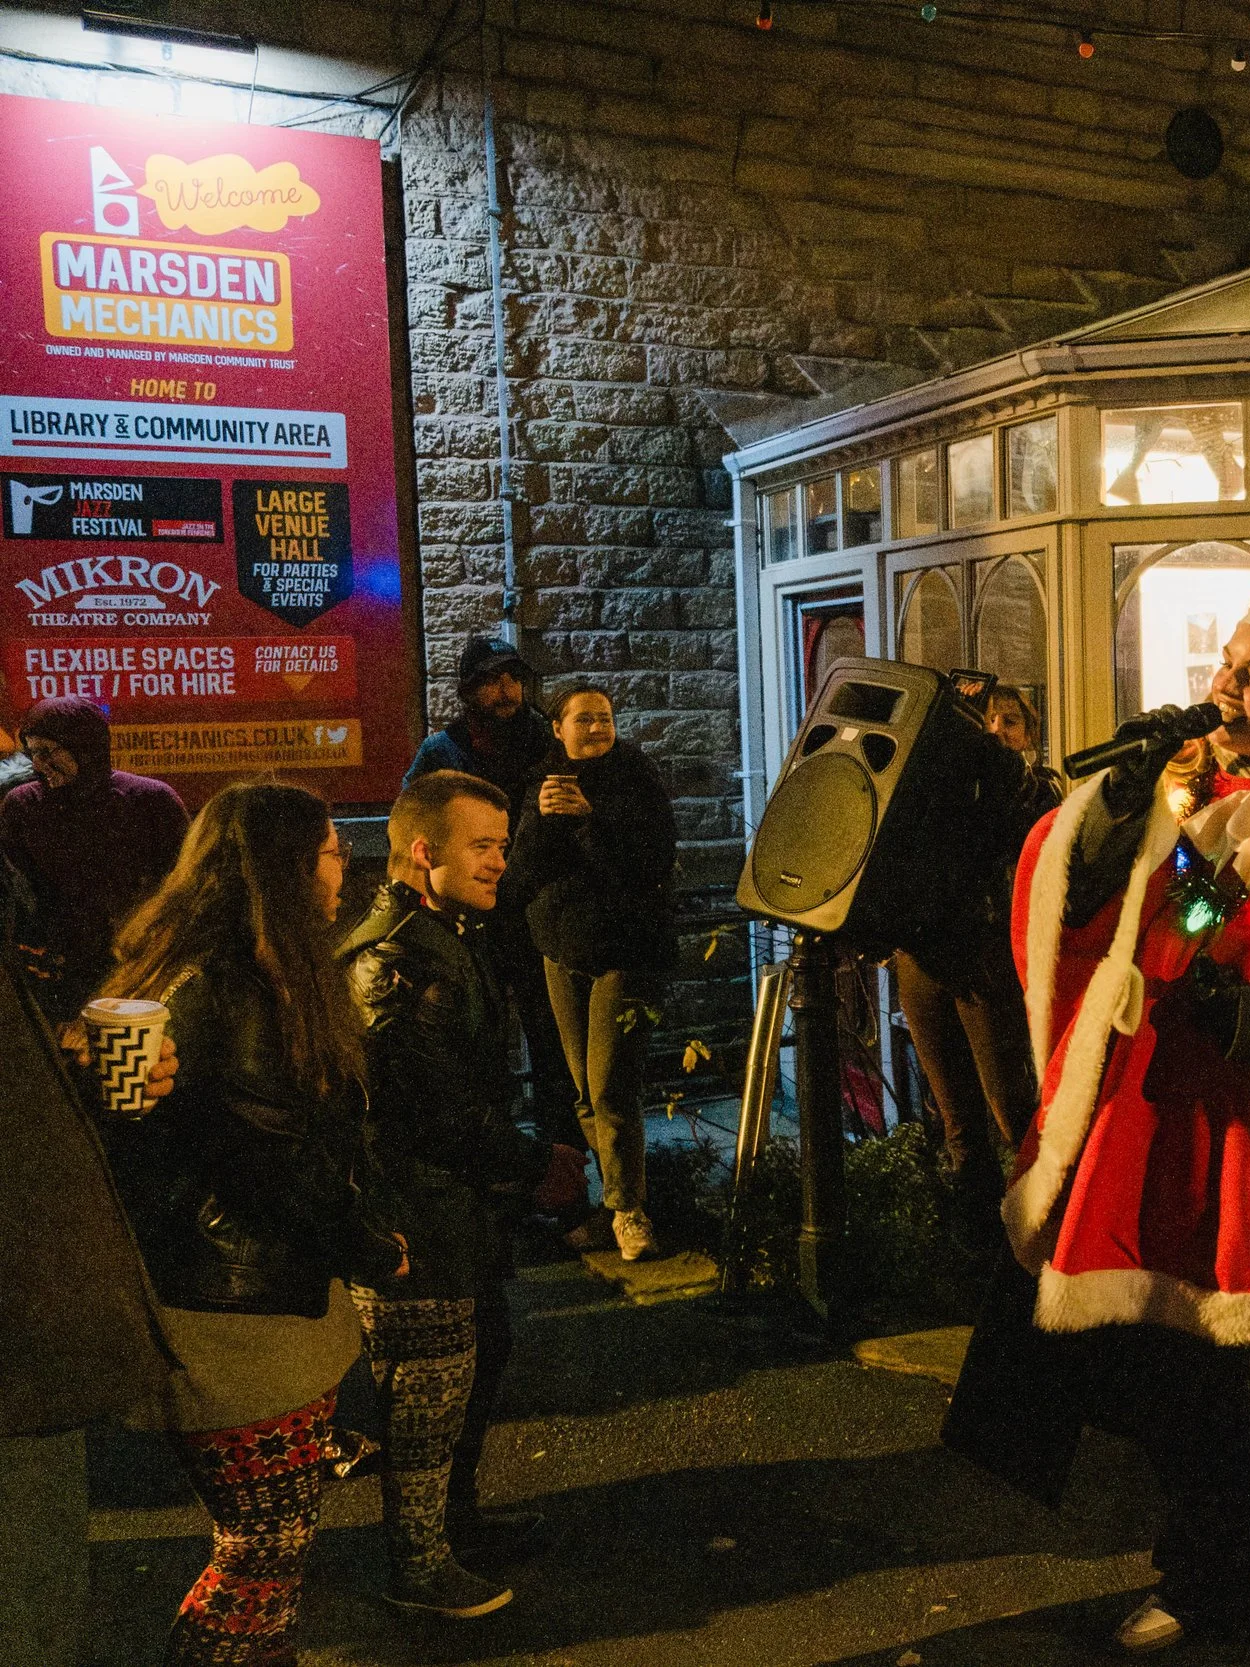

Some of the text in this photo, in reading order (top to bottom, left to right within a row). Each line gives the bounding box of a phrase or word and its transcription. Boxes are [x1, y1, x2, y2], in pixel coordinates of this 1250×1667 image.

[155, 176, 302, 211] Welcome
[57, 243, 275, 302] MARSDEN
[61, 295, 277, 345] MECHANICS
[46, 345, 296, 369] OWNED AND MANAGED BY MARSDEN COMMUNITY TRUST
[131, 379, 216, 400] HOME TO
[10, 409, 331, 447] LIBRARY & COMMUNITY AREA
[70, 482, 143, 501] MARSDEN
[256, 489, 327, 513] LARGE
[73, 500, 112, 517] JAZZ
[72, 518, 147, 537] FESTIVAL
[255, 514, 330, 538] VENUE
[270, 538, 324, 562] HALL
[253, 563, 338, 578] FOR PARTIES
[15, 555, 221, 610] MIKRON
[262, 577, 330, 592] & SPECIAL
[94, 598, 147, 607] Est. 1972
[271, 593, 324, 607] EVENTS
[28, 613, 212, 627] THEATRE COMPANY
[25, 646, 236, 672] FLEXIBLE SPACES
[255, 645, 336, 660] CONTACT US
[255, 659, 338, 673] FOR DETAILS
[26, 672, 236, 699] TO LET / FOR HIRE
